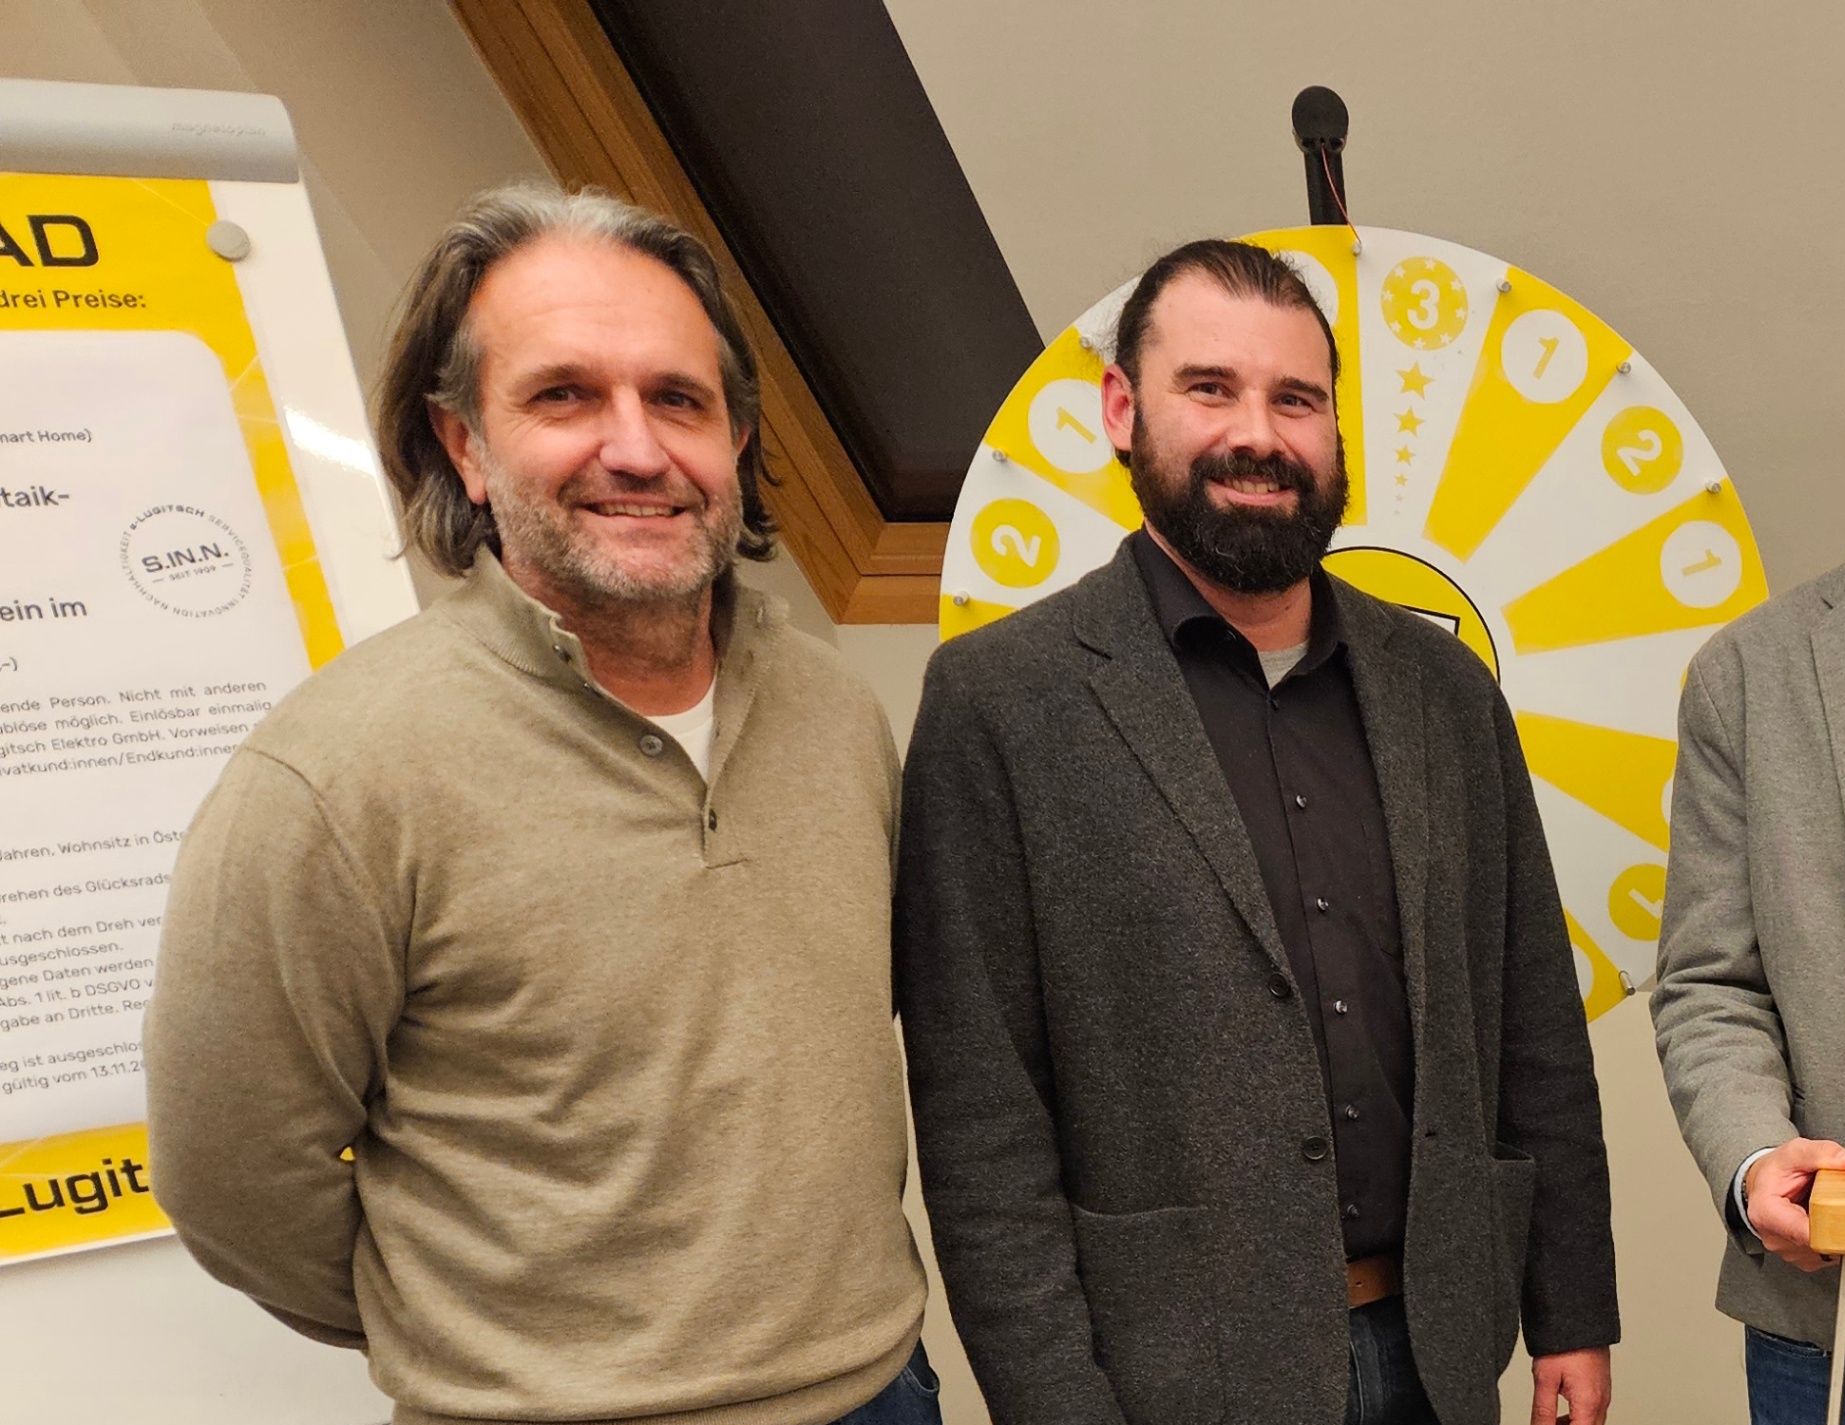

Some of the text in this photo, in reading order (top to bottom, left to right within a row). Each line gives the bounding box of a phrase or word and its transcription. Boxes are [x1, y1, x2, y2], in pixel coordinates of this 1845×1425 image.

[52, 288, 147, 308] Preise:
[1407, 279, 1440, 330] 3
[1532, 336, 1560, 380] 1
[37, 428, 92, 443] Home)
[1055, 406, 1096, 444] 1
[1616, 429, 1663, 477] 2
[142, 542, 229, 573] S.IN.N.
[991, 524, 1042, 567] 2
[1681, 548, 1722, 577] 1
[49, 596, 88, 618] im
[49, 695, 111, 709] Person.
[118, 688, 162, 703] Nicht
[169, 685, 196, 698] mit
[203, 681, 267, 696] anderen
[55, 713, 123, 731] möglich.
[129, 706, 200, 723] Einlösbar
[51, 736, 108, 751] Elektro
[112, 729, 166, 745] GmbH.
[168, 722, 249, 739] Vorweisen
[57, 835, 131, 855] Wohnsitz
[134, 833, 149, 846] in
[52, 883, 82, 898] des
[12, 929, 53, 944] nach
[57, 924, 92, 938] dem
[95, 918, 134, 933] Dreh
[42, 965, 92, 981] Daten
[94, 957, 154, 974] werden
[46, 989, 67, 1002] lit.
[70, 987, 82, 999] b
[84, 978, 141, 997] DSGVO
[0, 1015, 40, 1032] gabe
[44, 1011, 65, 1022] an
[68, 1003, 119, 1020] Dritte.
[23, 1055, 43, 1068] ist
[2, 1075, 49, 1094] gültig
[53, 1070, 87, 1083] vom
